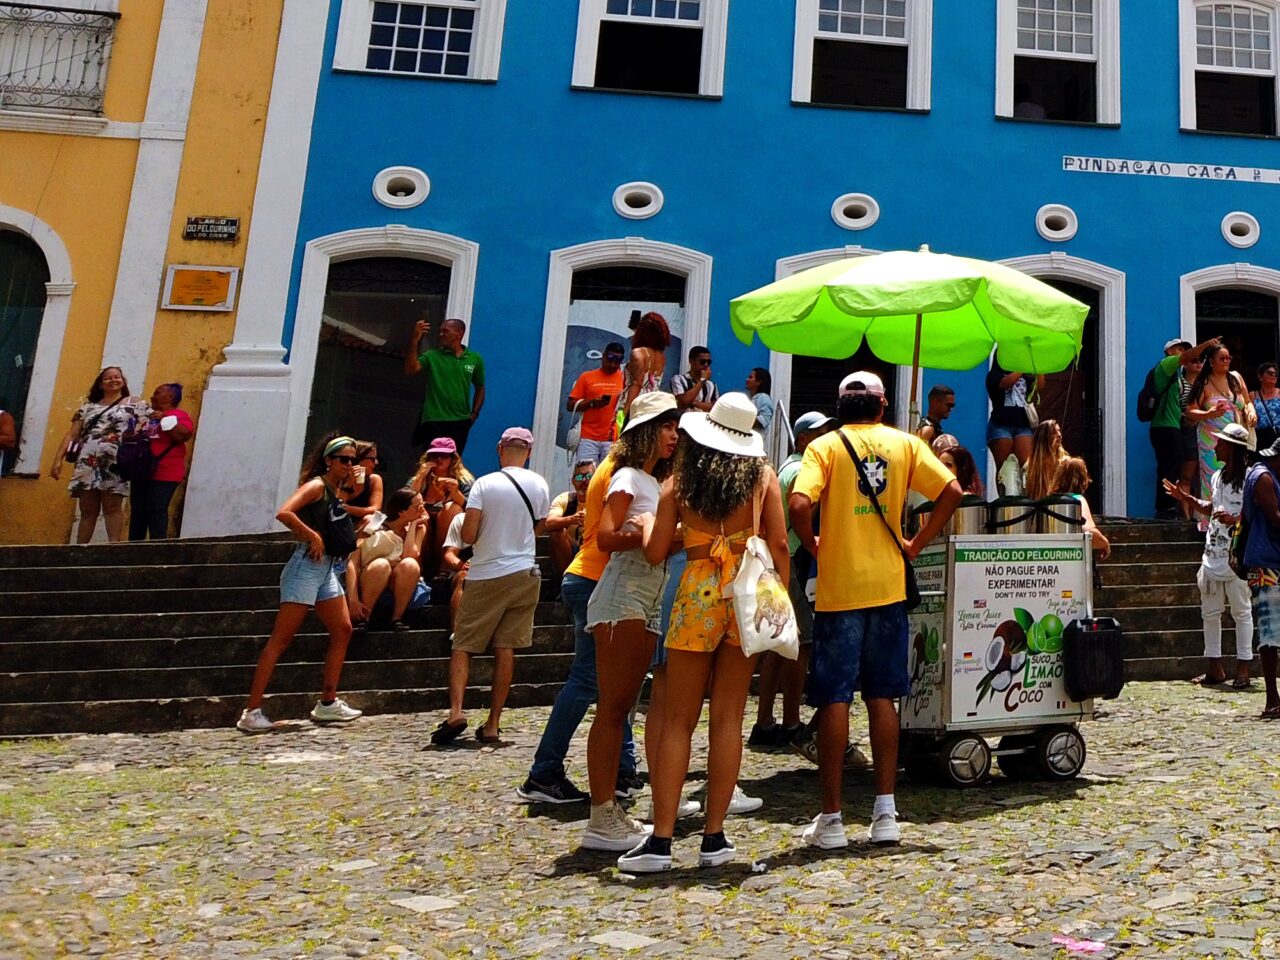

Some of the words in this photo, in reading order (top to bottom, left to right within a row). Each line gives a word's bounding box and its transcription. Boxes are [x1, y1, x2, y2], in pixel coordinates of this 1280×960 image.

[1064, 157, 1171, 175] FUNDAÇÃO
[1187, 165, 1237, 179] CASA
[197, 225, 236, 233] PELOURINHO
[854, 505, 889, 515] BRAIL
[964, 550, 1009, 562] TRADIÇÃO
[1011, 551, 1025, 560] DO
[1027, 550, 1083, 560] PELOURINHO
[985, 564, 1003, 576] NÃO
[1006, 566, 1034, 576] PAGUE
[1037, 565, 1059, 575] PARA
[988, 579, 1056, 590] EXPERIMENTAR!
[983, 609, 1002, 622] Juice
[1031, 655, 1050, 664] SUCO
[1023, 657, 1063, 688] LIMÃO
[1039, 681, 1052, 689] COM
[1004, 681, 1044, 712] COCO
